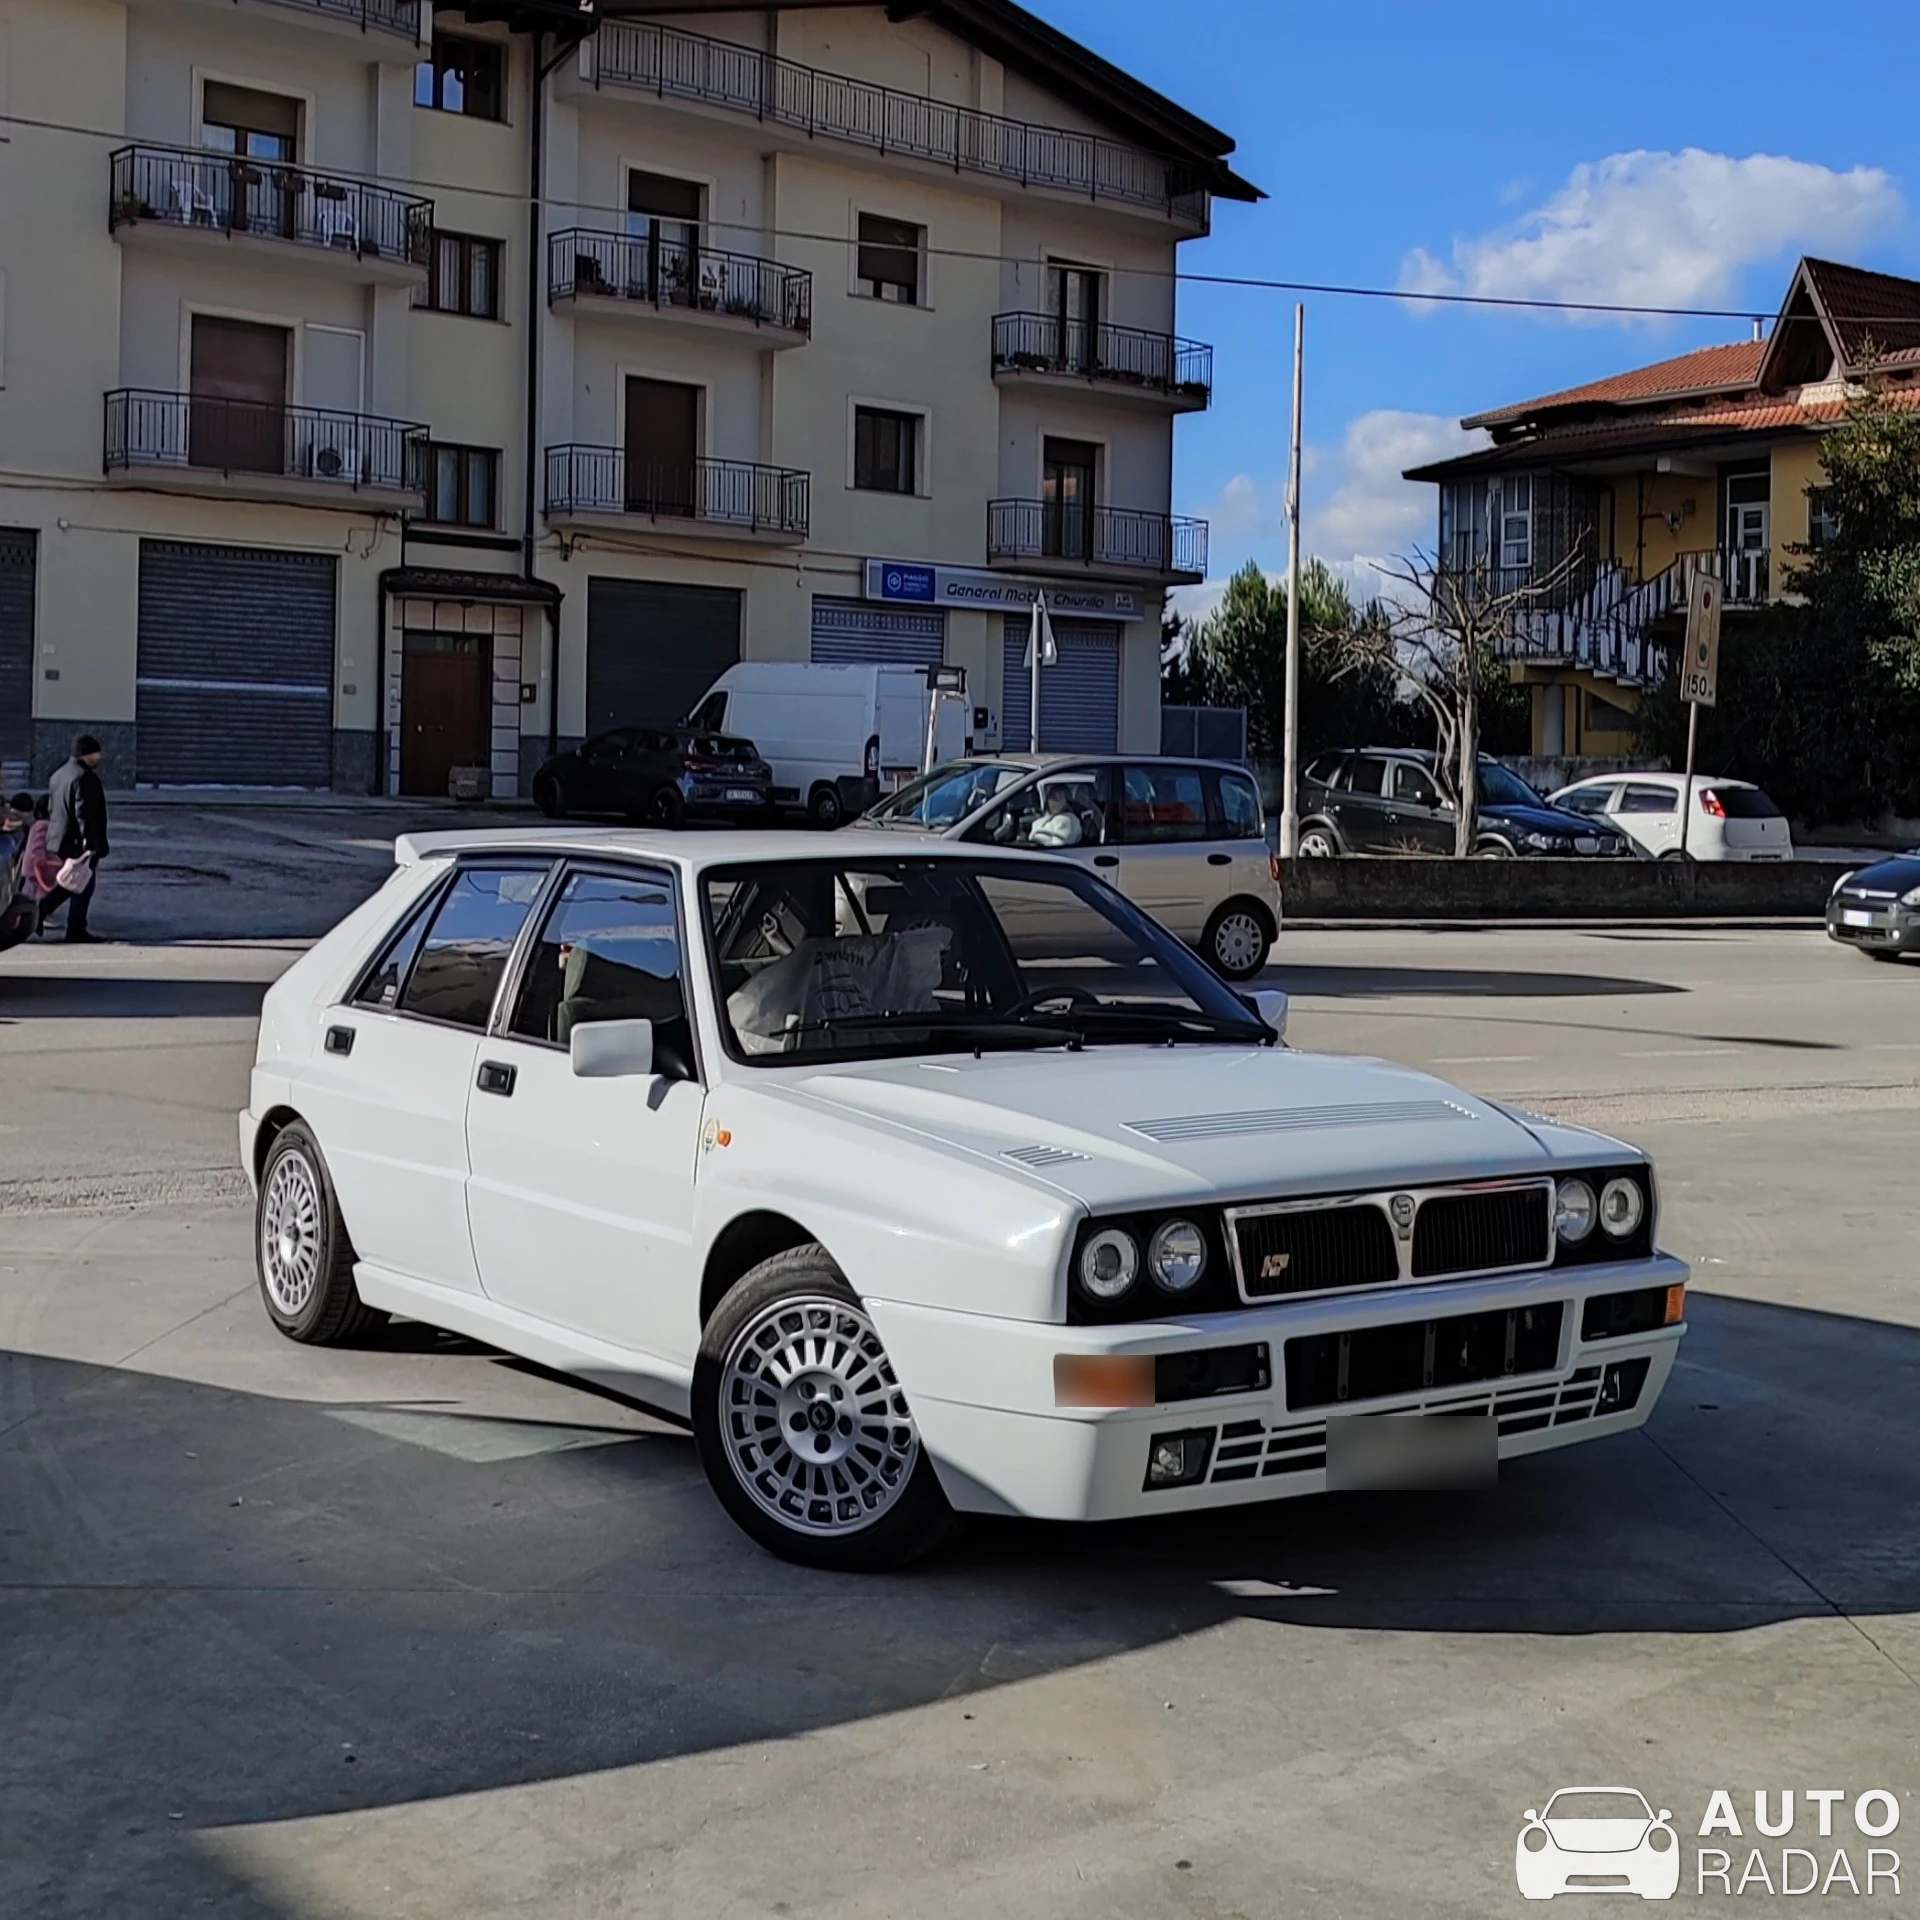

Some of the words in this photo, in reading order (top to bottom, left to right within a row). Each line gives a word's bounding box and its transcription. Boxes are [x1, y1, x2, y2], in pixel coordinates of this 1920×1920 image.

[946, 582, 1001, 600] General
[1053, 593, 1105, 609] Chiurillo
[1687, 673, 1707, 696] 150
